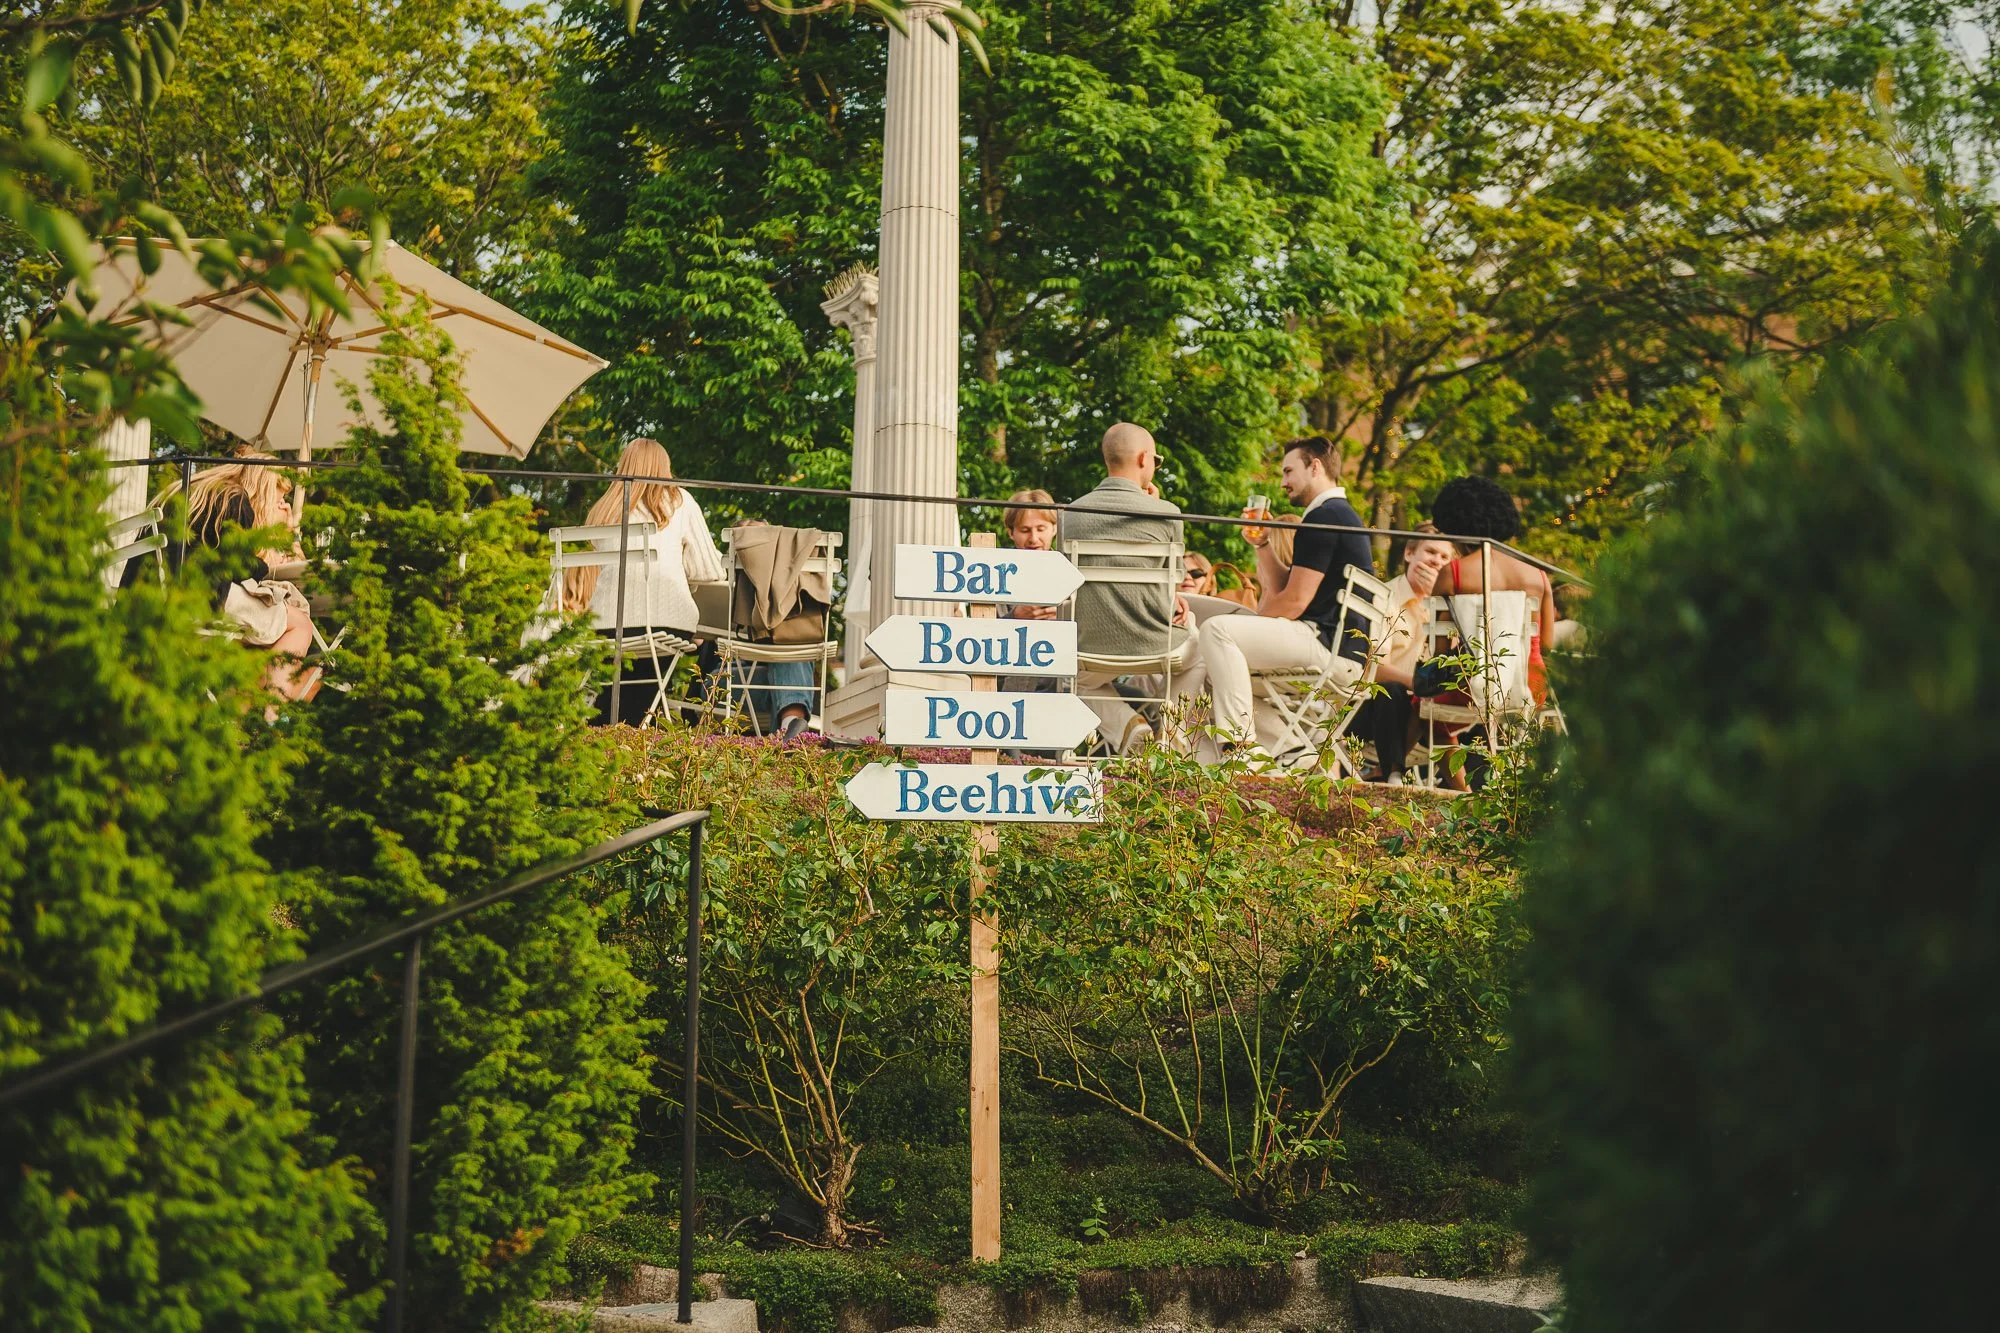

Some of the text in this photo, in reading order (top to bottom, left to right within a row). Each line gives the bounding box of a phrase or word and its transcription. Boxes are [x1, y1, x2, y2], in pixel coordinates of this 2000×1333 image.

[932, 551, 1018, 595] Bar
[919, 622, 1055, 667] Boule
[925, 697, 1028, 741] Pool
[895, 769, 1090, 815] Beehive
